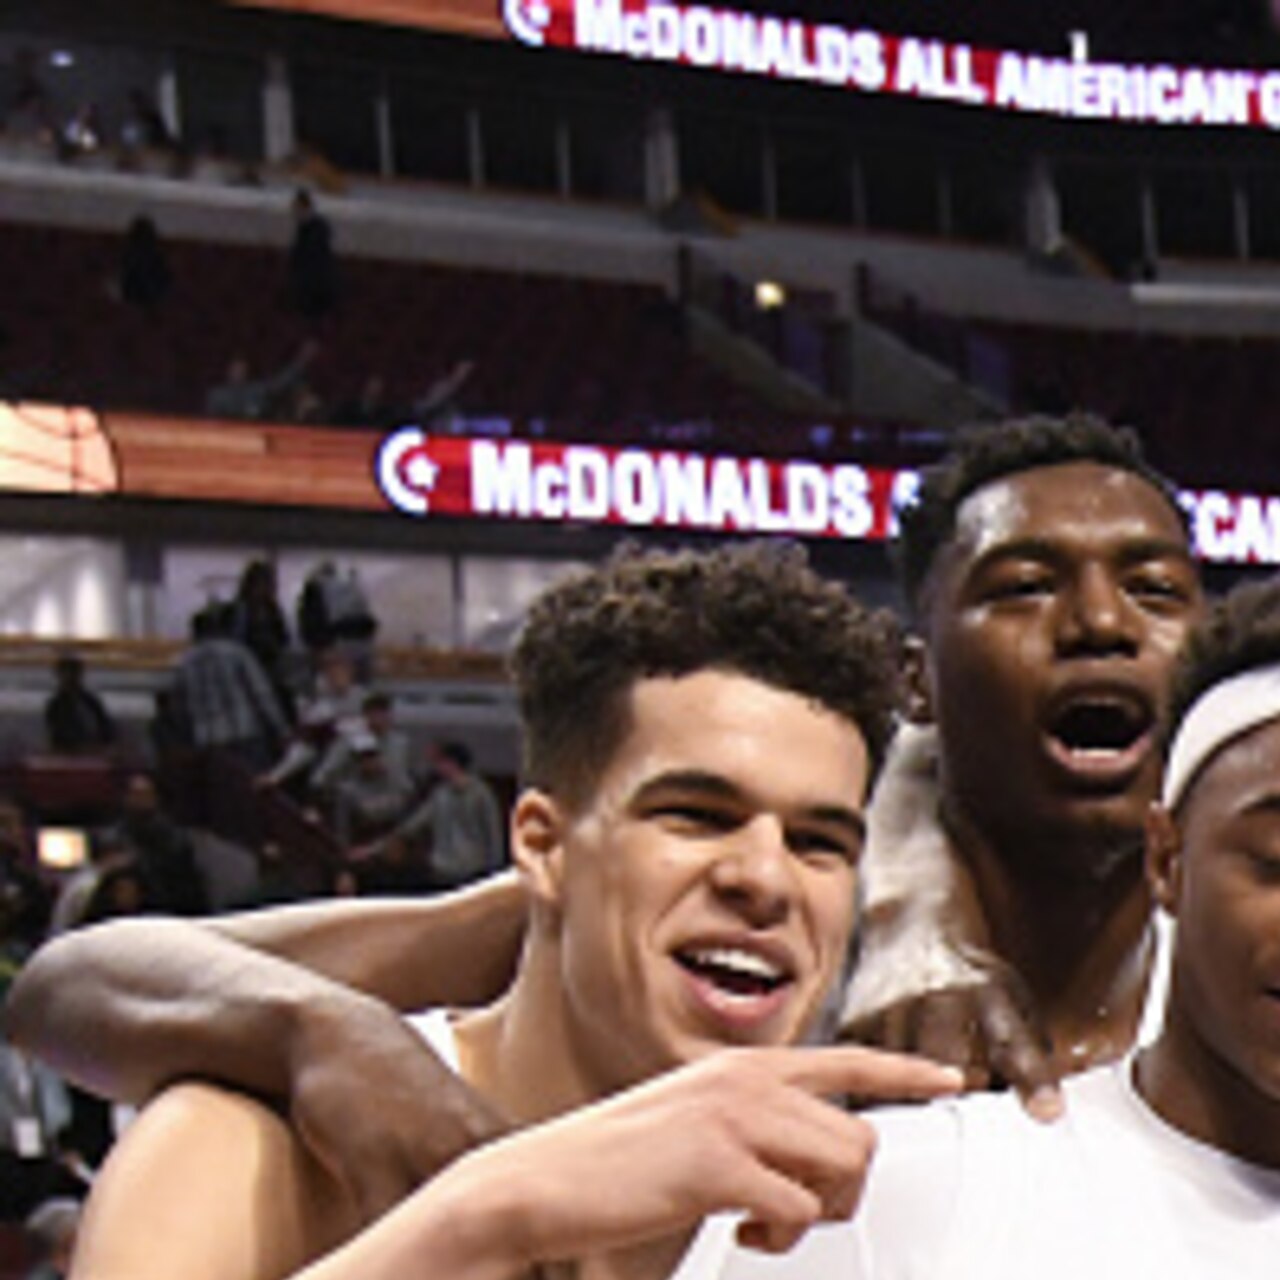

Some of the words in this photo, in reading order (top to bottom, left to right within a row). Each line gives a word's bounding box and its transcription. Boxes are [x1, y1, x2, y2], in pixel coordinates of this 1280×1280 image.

[574, 0, 887, 88] McDONALDS
[895, 36, 986, 104] ALL
[469, 439, 874, 537] McDONALDS
